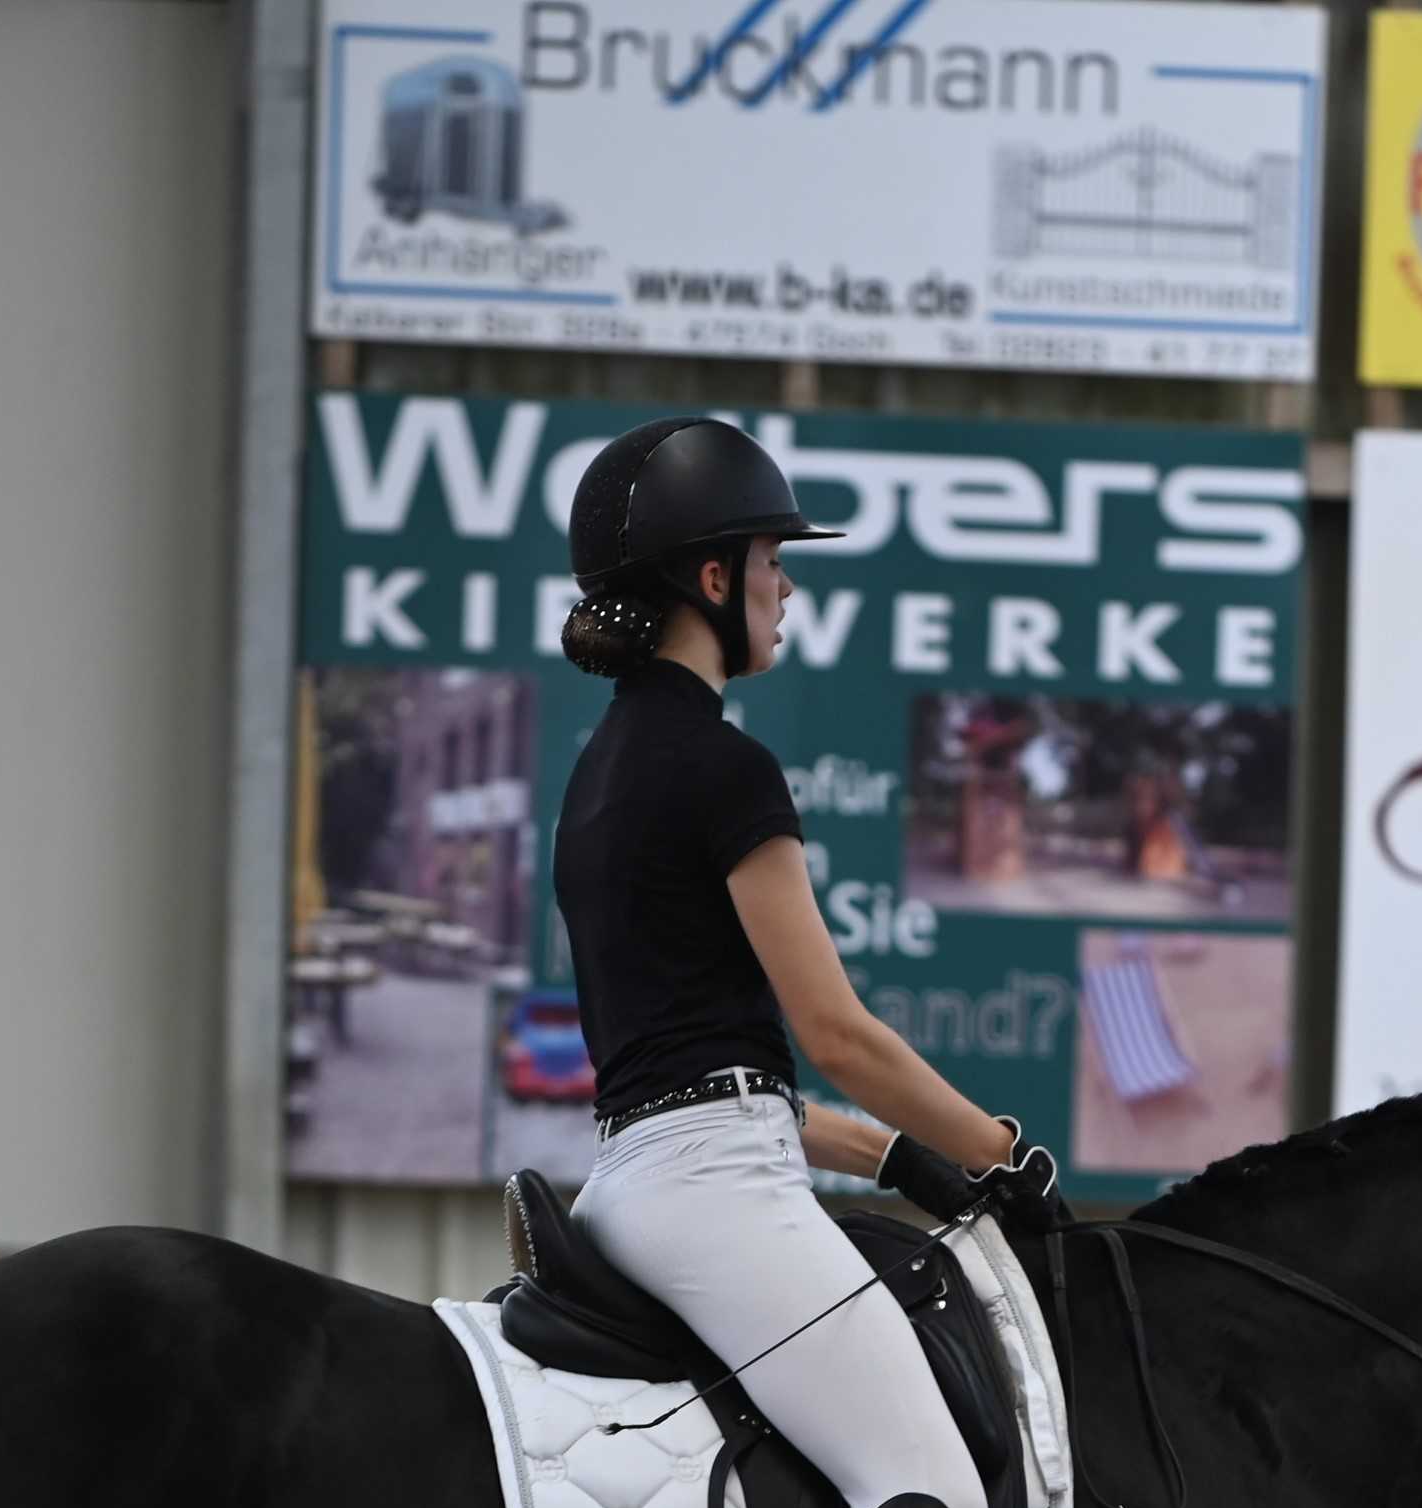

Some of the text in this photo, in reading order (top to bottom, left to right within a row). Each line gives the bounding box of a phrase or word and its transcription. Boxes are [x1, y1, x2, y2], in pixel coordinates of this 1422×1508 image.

[521, 0, 1119, 116] Bruckmann
[316, 392, 1306, 574] Wbers
[340, 565, 1277, 687] KIEWERKE
[783, 753, 898, 815] ofür
[828, 880, 940, 957] Sie
[854, 966, 1074, 1058] and?
